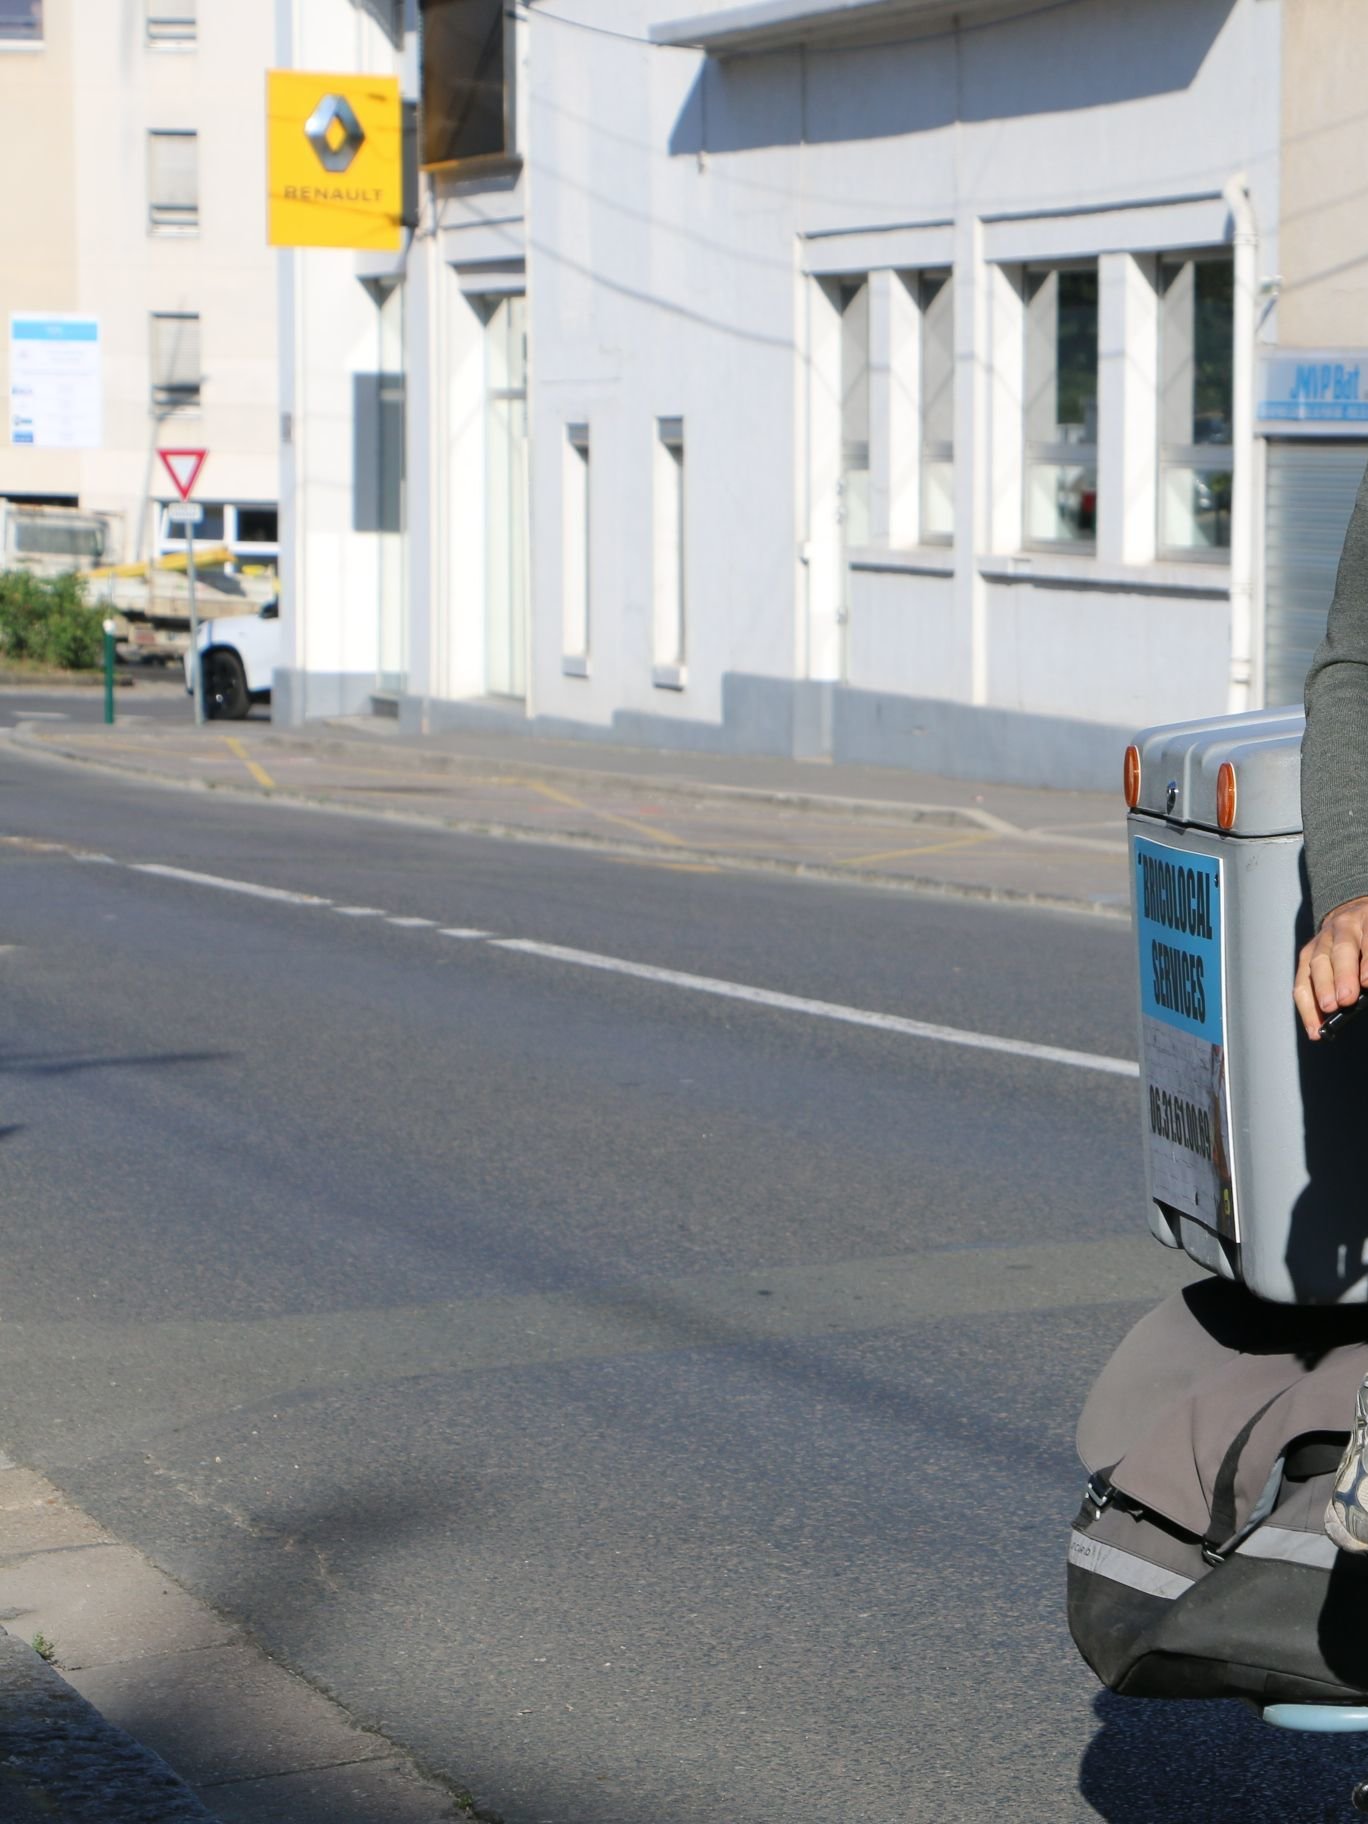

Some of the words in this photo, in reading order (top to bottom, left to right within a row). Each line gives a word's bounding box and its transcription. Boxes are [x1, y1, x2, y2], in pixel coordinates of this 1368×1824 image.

[284, 184, 383, 202] RENAULT
[1143, 854, 1212, 940] BRICOLOCAL
[1152, 939, 1206, 1025] SERVICES
